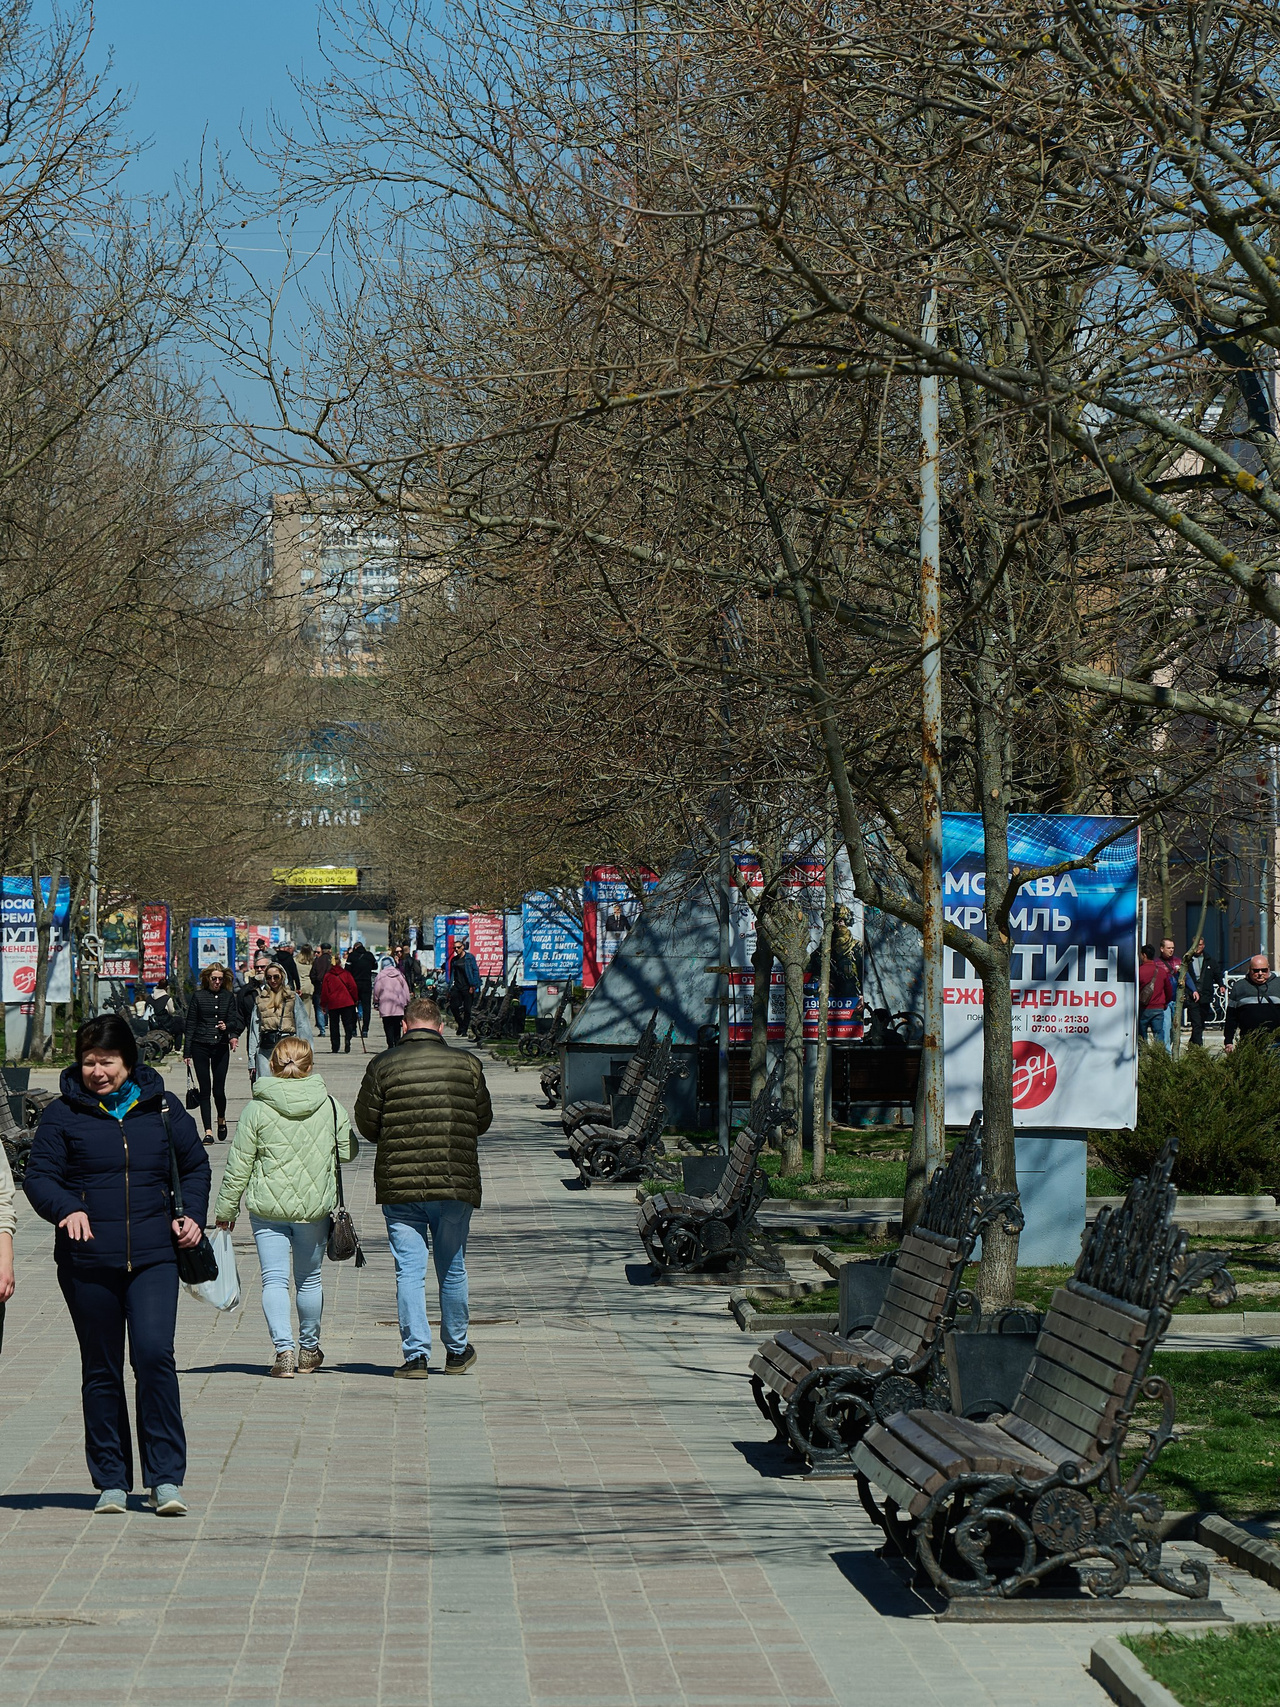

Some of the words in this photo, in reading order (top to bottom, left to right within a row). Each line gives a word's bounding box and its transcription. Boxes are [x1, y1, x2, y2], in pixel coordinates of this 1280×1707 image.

[944, 871, 1079, 897] МОКВА
[943, 906, 1072, 932] КРМЛЬ
[532, 951, 541, 961] В.
[542, 951, 551, 961] В.
[943, 944, 1119, 983] ПТИН
[942, 987, 1117, 1009] ЕЖЕДЕЛЬНО
[1031, 1014, 1057, 1023] 12:00
[1064, 1014, 1089, 1023] 21:30
[1031, 1024, 1057, 1033] 07:00
[1064, 1025, 1090, 1034] 12:00
